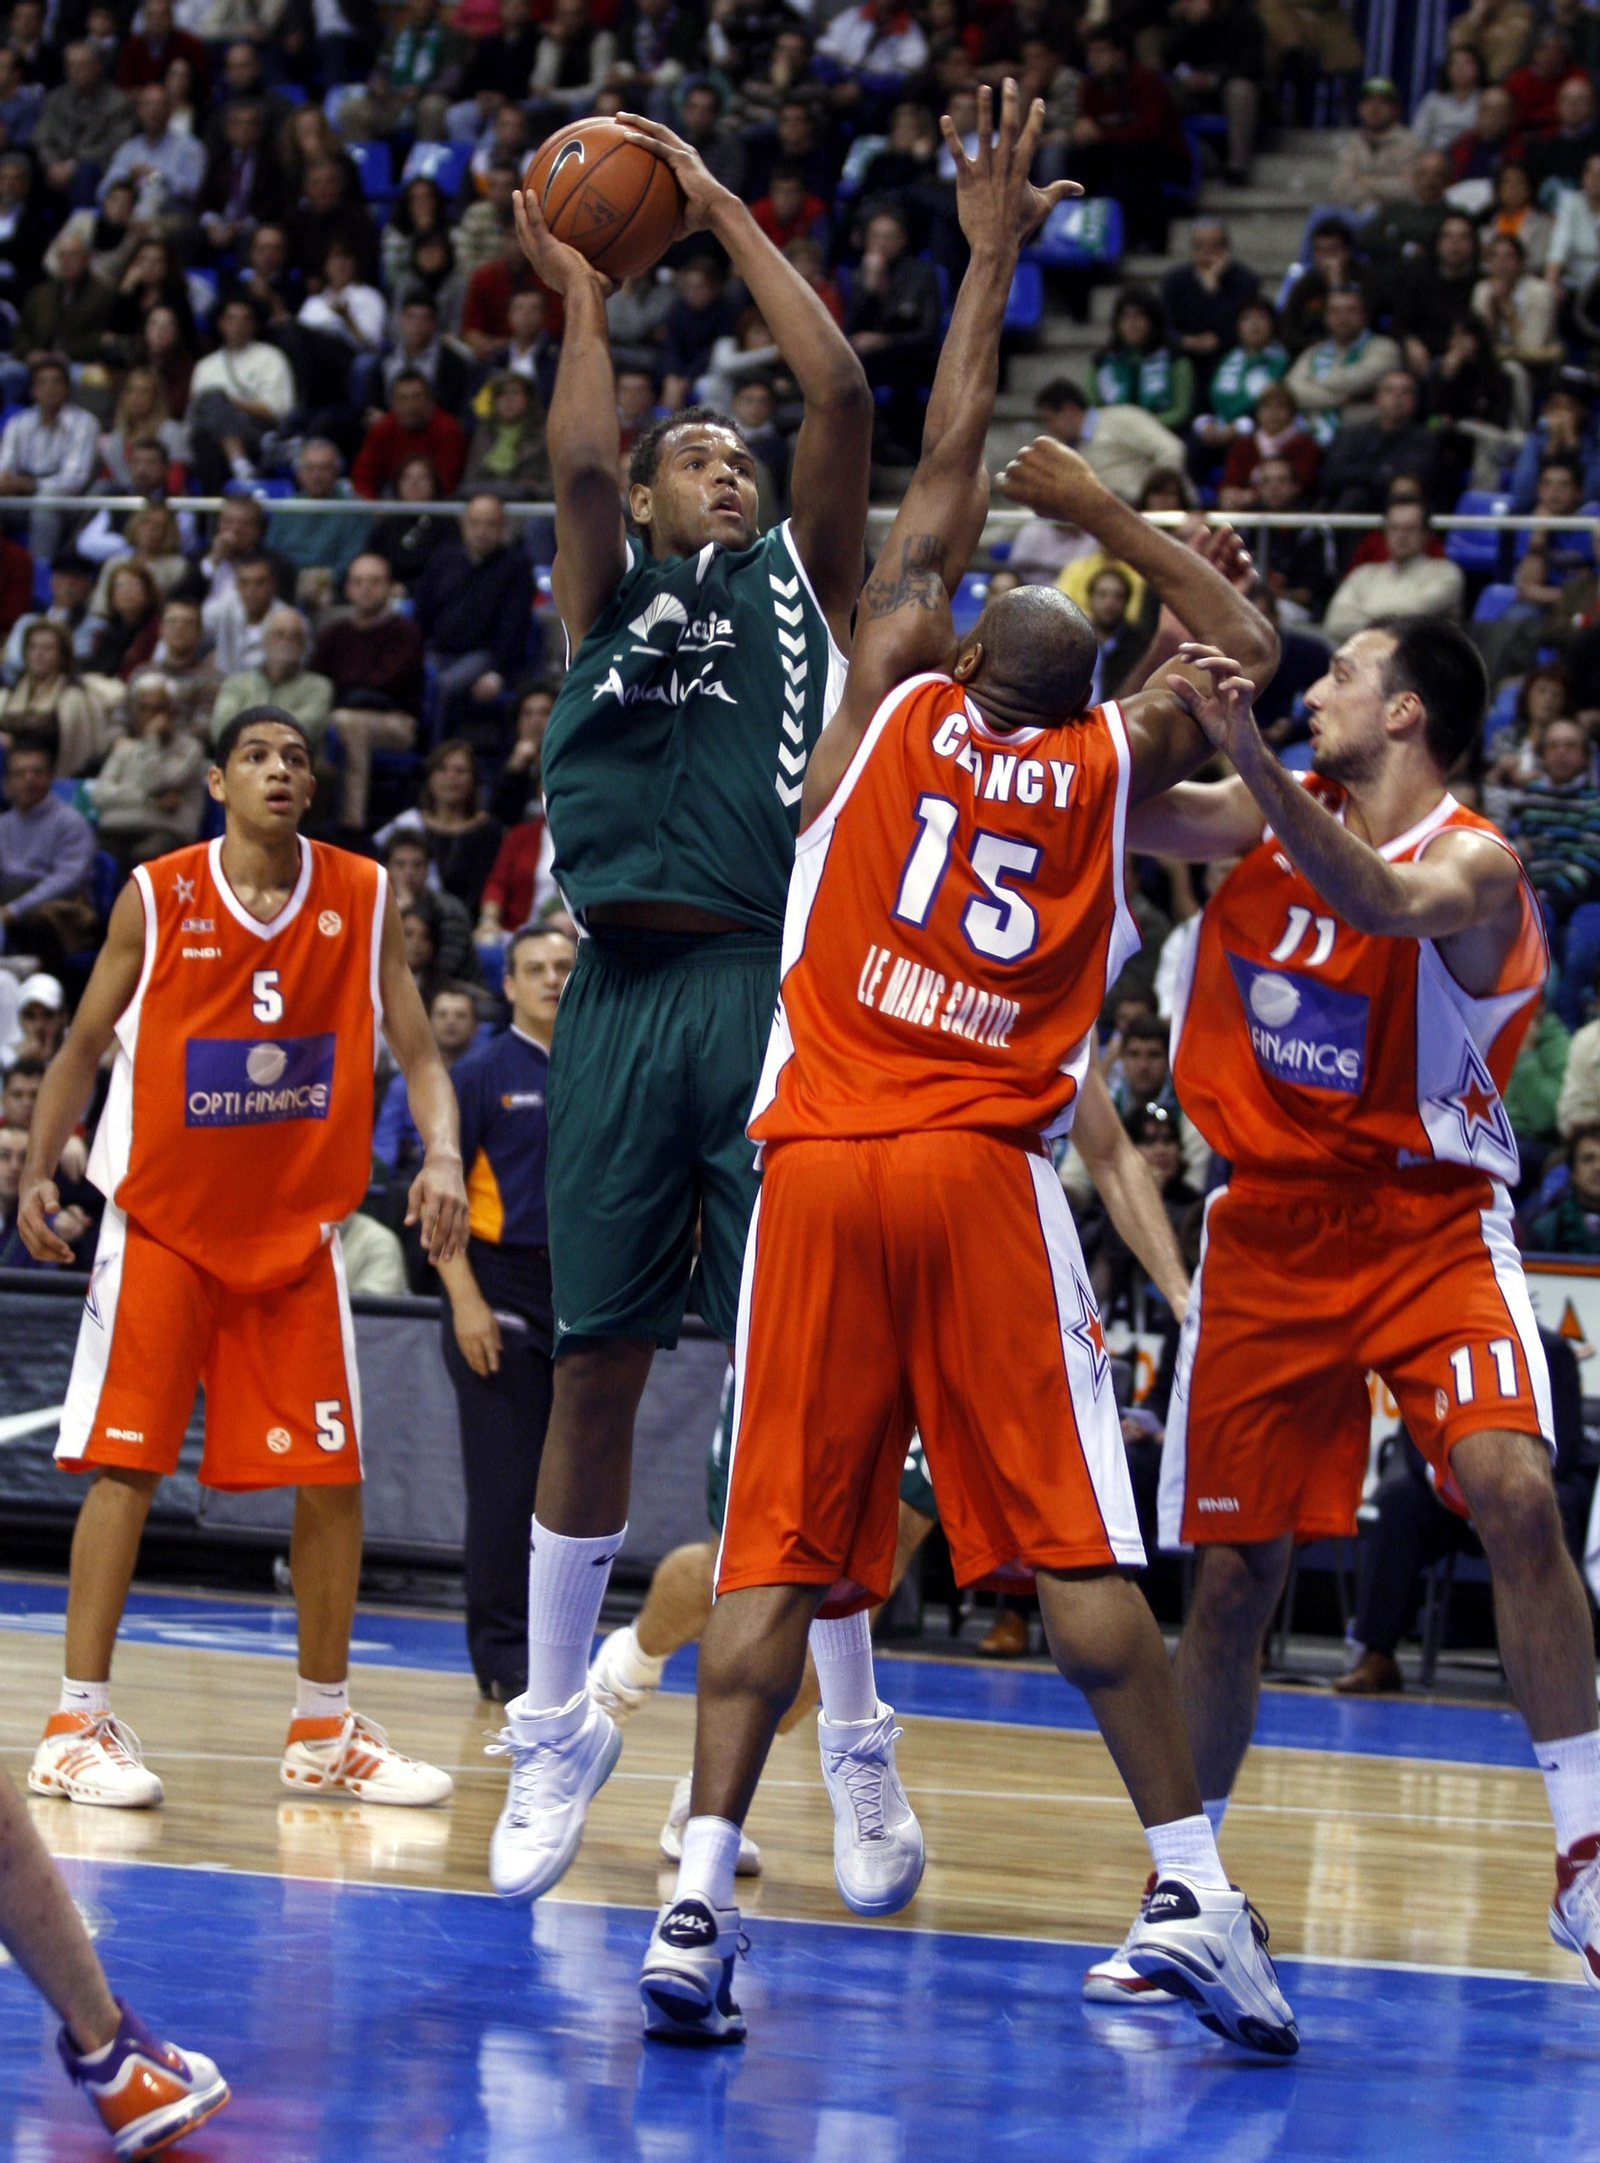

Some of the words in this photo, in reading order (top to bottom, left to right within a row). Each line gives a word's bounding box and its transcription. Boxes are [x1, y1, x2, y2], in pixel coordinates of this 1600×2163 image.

[890, 791, 1044, 966] 15
[1268, 904, 1337, 967] 11
[252, 970, 284, 1024] 5
[857, 944, 892, 1008] LE
[878, 956, 946, 1027] MANS
[940, 980, 1021, 1048] SARTHE
[1251, 1026, 1361, 1079] FINANCE
[188, 1091, 241, 1116] OPTI
[244, 1083, 328, 1115] FINANCE
[1449, 1338, 1520, 1406] 11
[313, 1399, 346, 1452] 5
[663, 1913, 709, 1933] MAX
